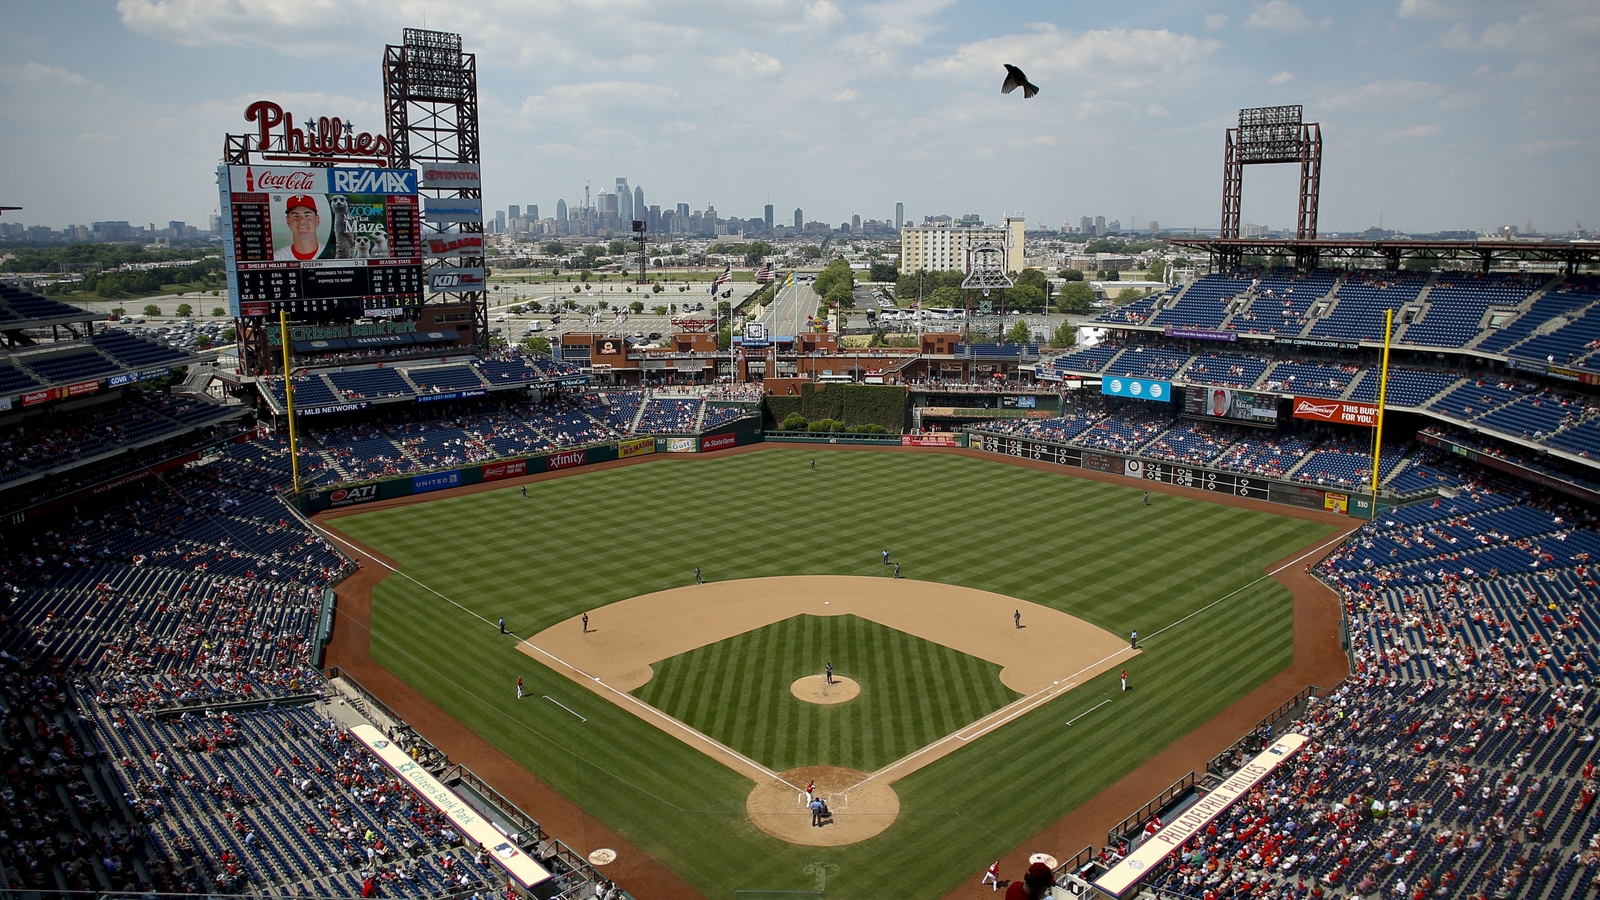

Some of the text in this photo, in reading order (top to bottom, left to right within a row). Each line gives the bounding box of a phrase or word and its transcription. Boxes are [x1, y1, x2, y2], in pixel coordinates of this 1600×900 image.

[244, 100, 391, 156] Phillies
[258, 171, 316, 190] Coca-Cola
[334, 170, 410, 193] RE/MAX
[349, 207, 371, 216] ZOO
[344, 220, 384, 233] Maze
[291, 320, 417, 341] Citizens Bank Park
[1293, 339, 1338, 348] CSNPHILLY.COM
[111, 376, 127, 384] GOYA
[418, 393, 457, 402] 1-800-JEFF-NOW
[322, 403, 358, 413] NETWORK
[1300, 404, 1334, 414] Budweiser
[1342, 404, 1380, 416] THIS BUD'S
[1357, 415, 1373, 424] YOU.
[673, 441, 690, 450] Gulf
[550, 452, 584, 468] xfinity
[126, 470, 150, 484] UNIVERSITY
[416, 478, 448, 487] UNITED
[346, 485, 376, 499] ATI
[409, 771, 475, 825] Citizens Bank Park
[1158, 763, 1267, 846] PHILADELPHIA PHILLIES
